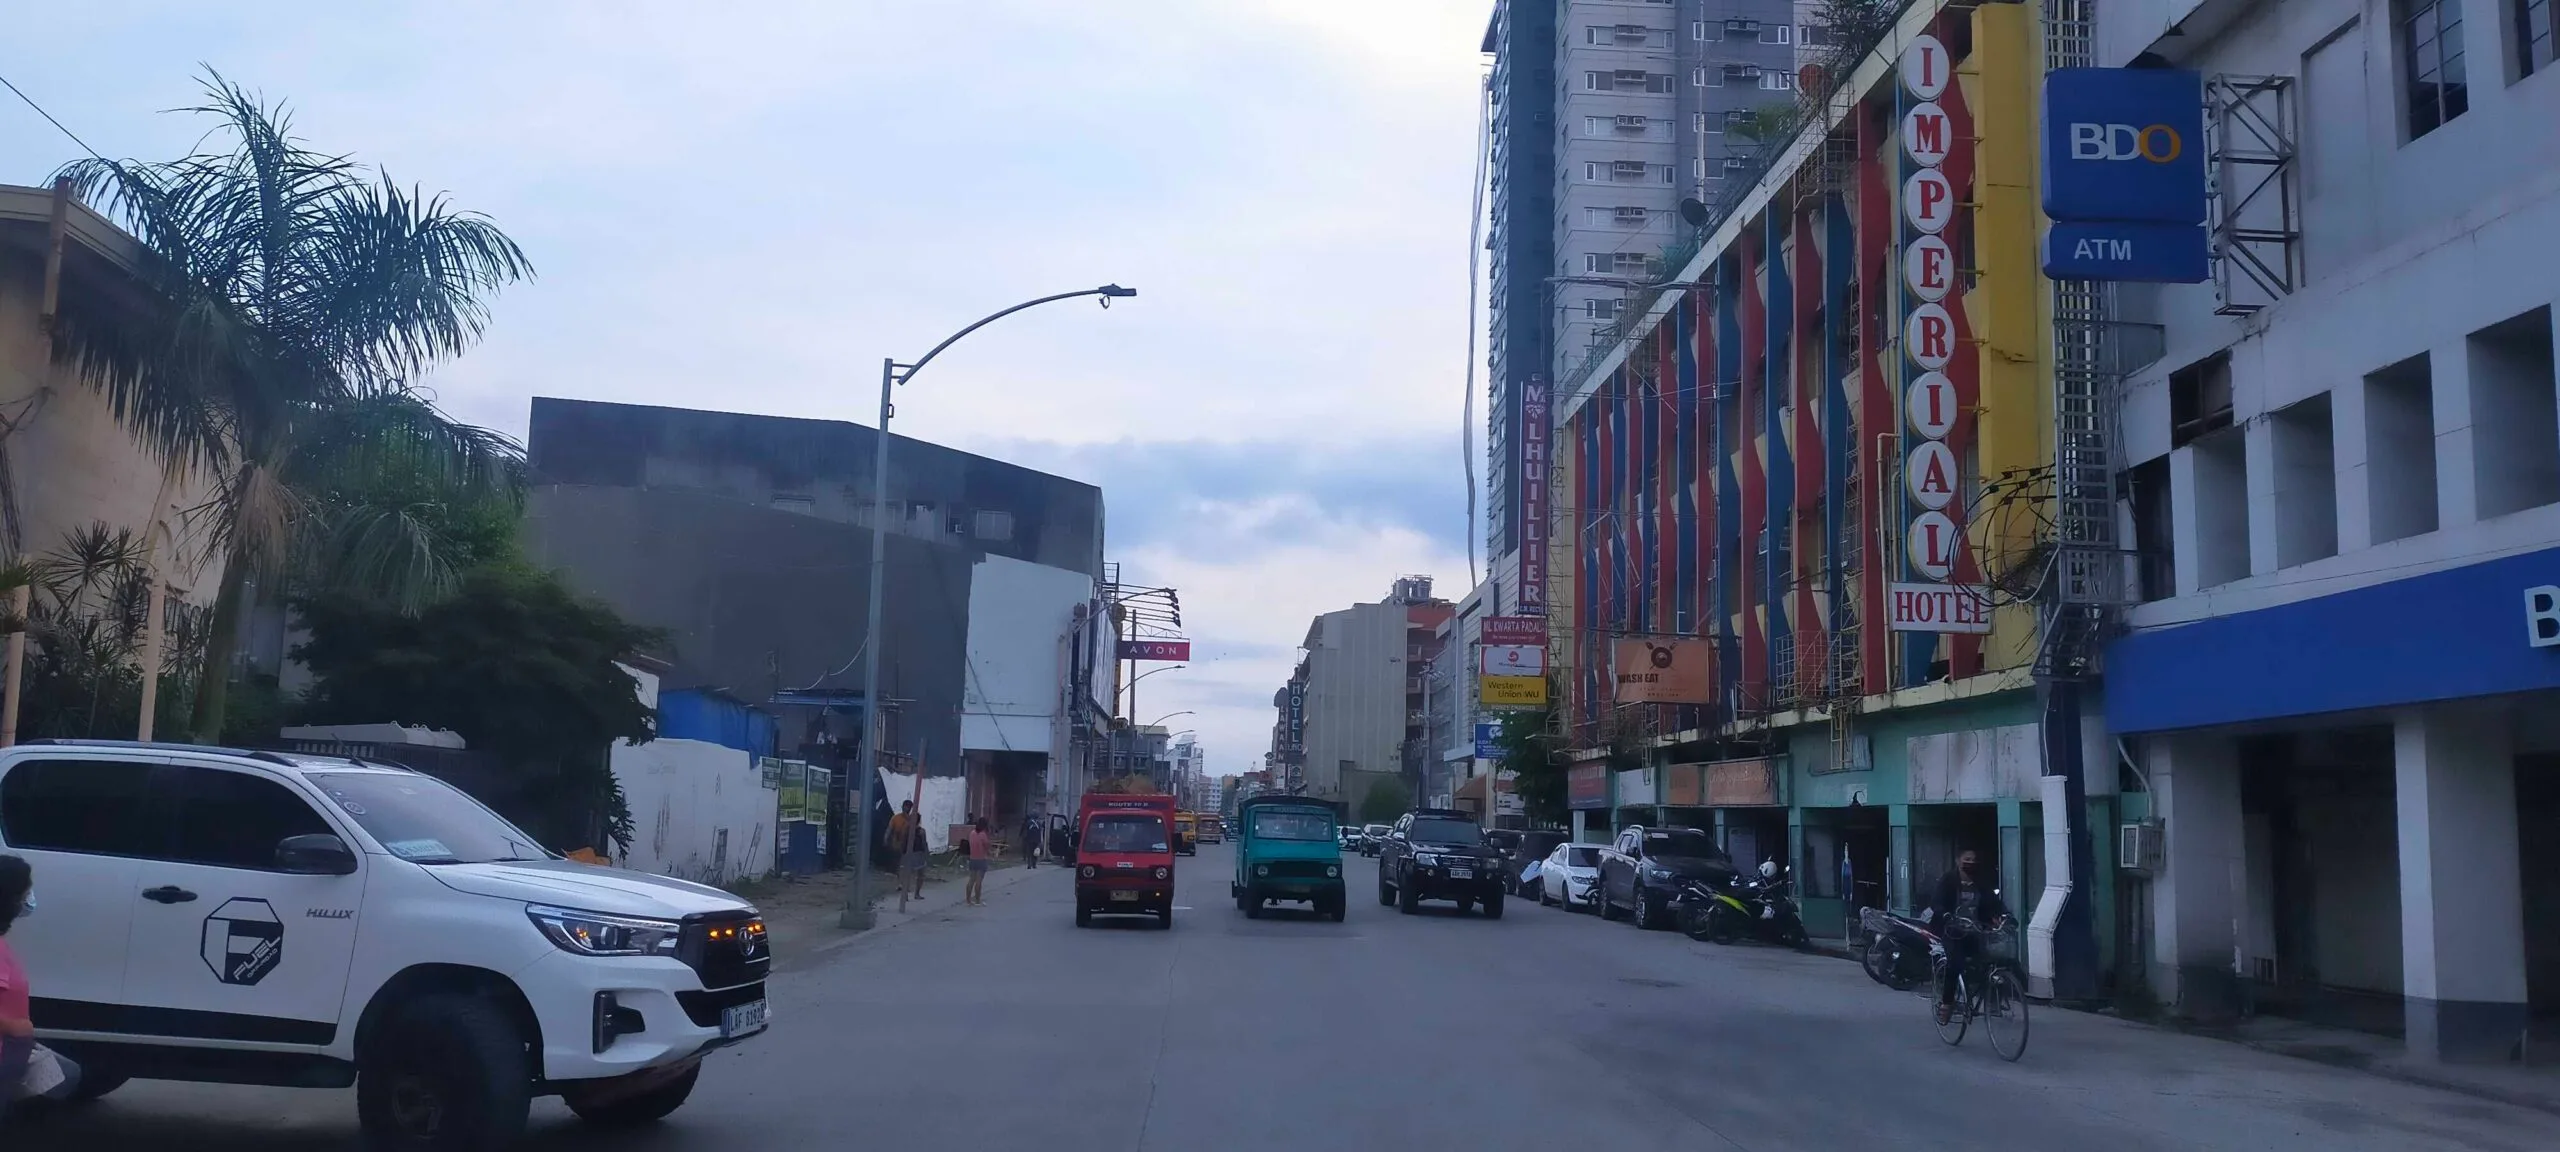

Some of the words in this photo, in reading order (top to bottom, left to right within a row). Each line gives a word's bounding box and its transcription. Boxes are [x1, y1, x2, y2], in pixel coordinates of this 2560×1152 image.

[2070, 122, 2182, 164] BDO
[2073, 238, 2132, 261] ATM
[1913, 47, 1951, 567] IMPERIAL
[1894, 591, 1989, 625] HOTEL
[1493, 620, 1520, 632] KWARTA
[1129, 646, 1177, 655] AVON
[1487, 680, 1524, 690] Western
[1644, 673, 1660, 683] EAT
[1498, 690, 1522, 698] Union
[1291, 684, 1302, 743] HOTEL
[305, 908, 354, 919] HILUX
[232, 936, 281, 981] FUEL
